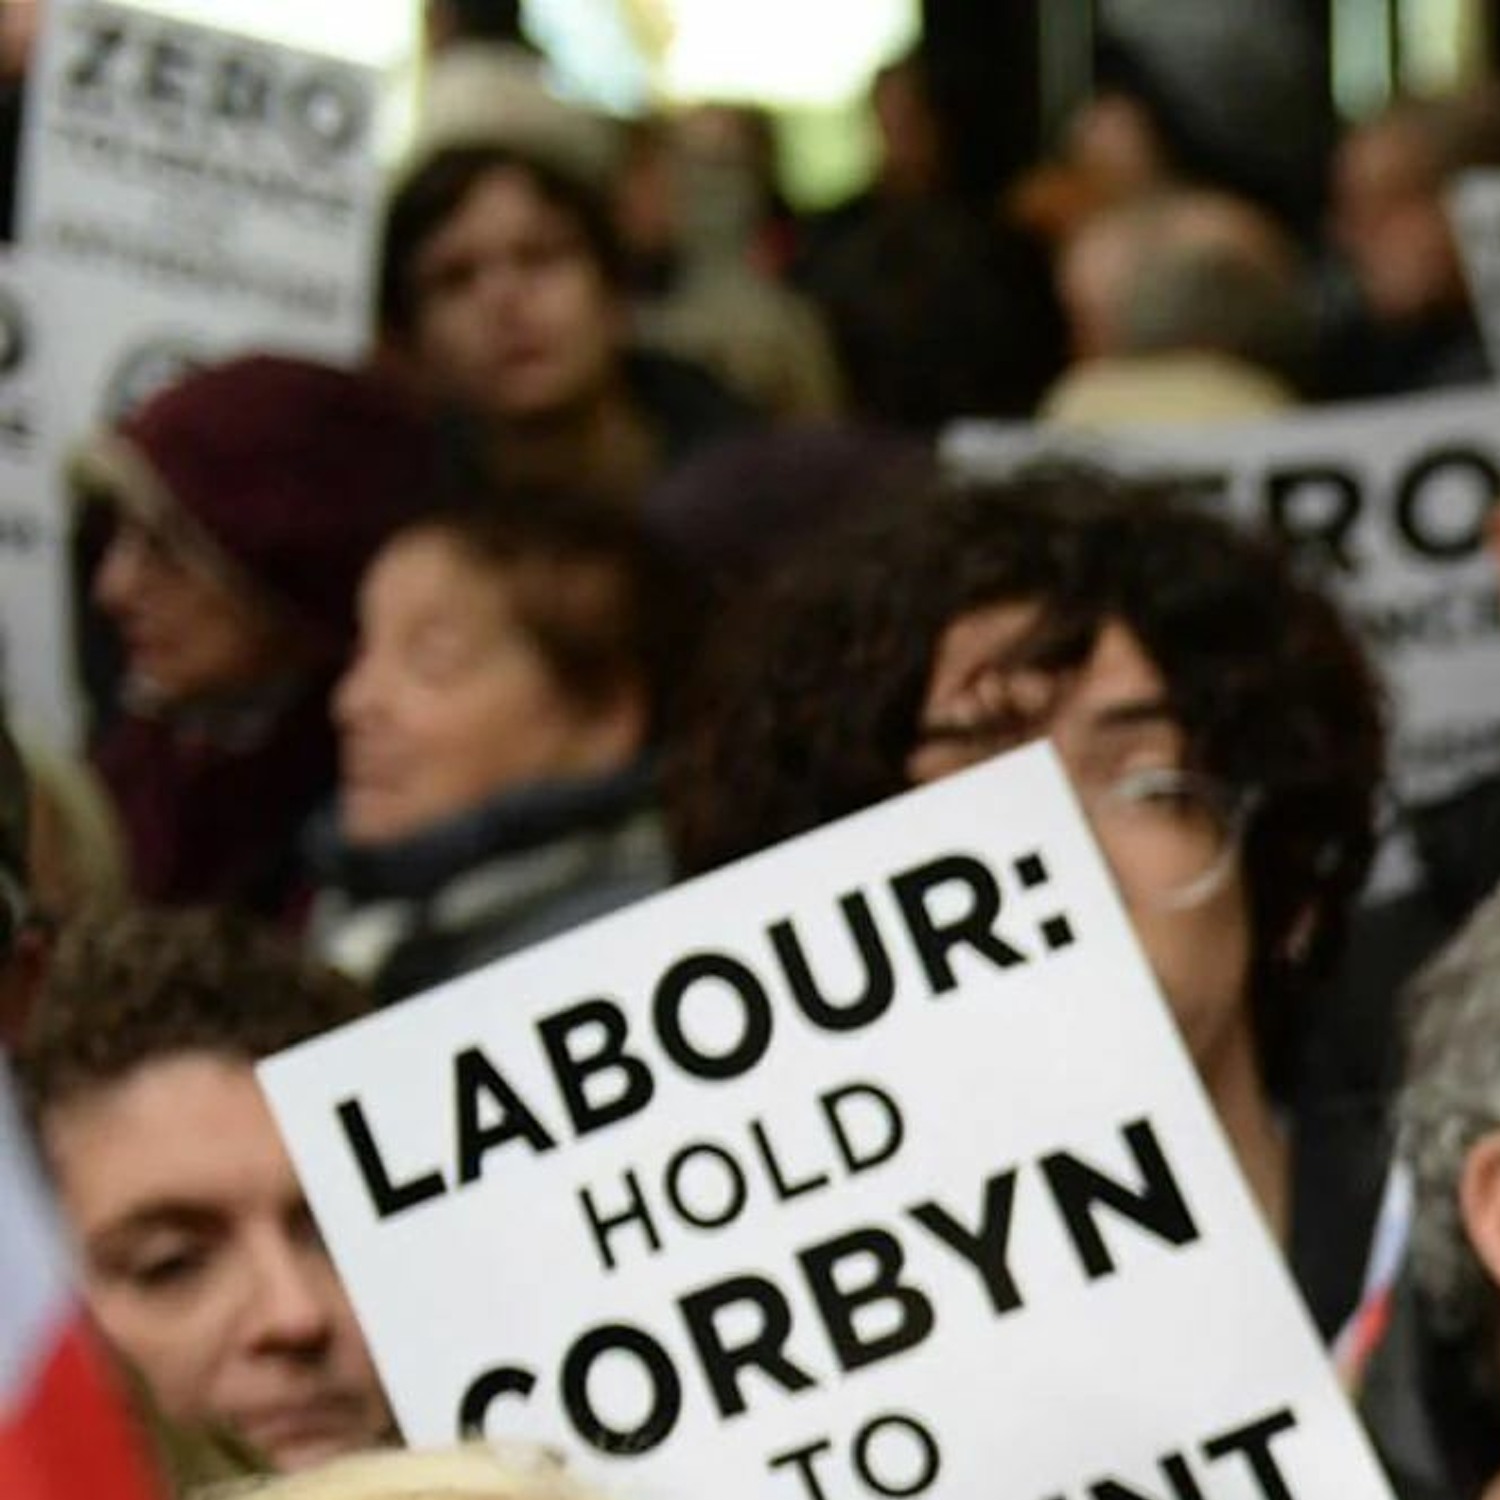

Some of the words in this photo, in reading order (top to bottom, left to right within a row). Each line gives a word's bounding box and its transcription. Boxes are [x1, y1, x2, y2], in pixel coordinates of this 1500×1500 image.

[64, 16, 368, 164] ZERO
[335, 852, 1076, 1219] LABOUR:
[457, 1118, 1201, 1458] CORBYN
[579, 1082, 905, 1270] HOLD
